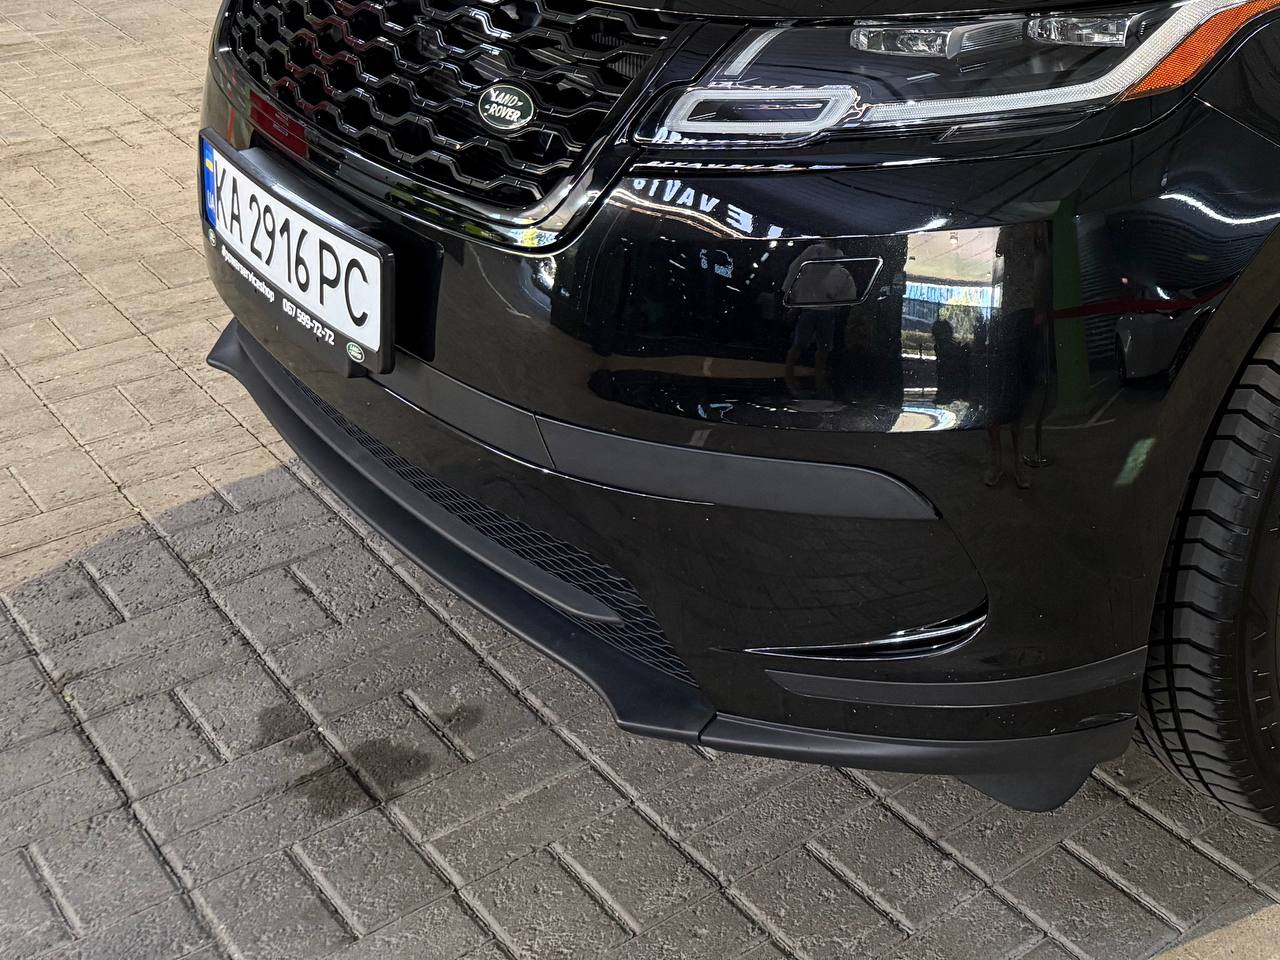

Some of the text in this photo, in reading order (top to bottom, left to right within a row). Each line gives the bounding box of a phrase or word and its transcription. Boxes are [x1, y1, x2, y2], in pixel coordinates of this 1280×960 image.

[490, 88, 519, 107] LAND
[488, 103, 521, 122] ROVER
[249, 193, 310, 293] 2916
